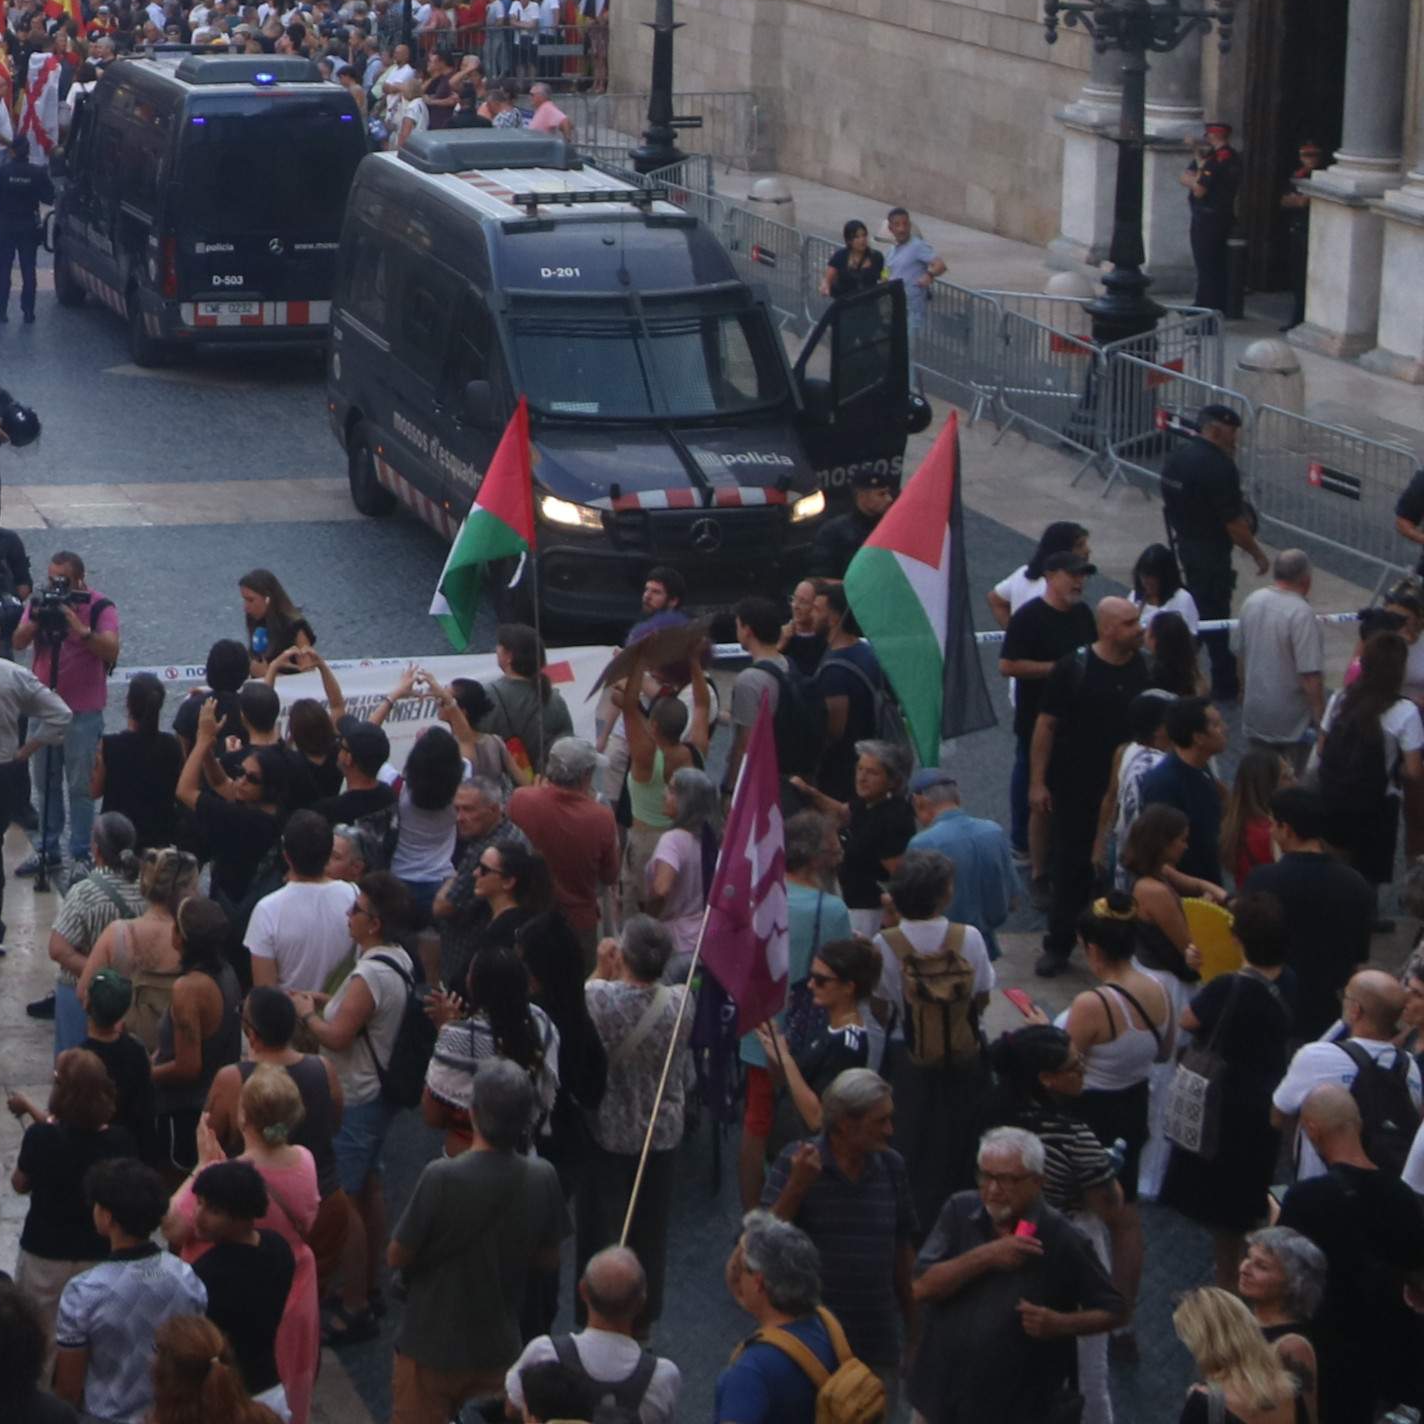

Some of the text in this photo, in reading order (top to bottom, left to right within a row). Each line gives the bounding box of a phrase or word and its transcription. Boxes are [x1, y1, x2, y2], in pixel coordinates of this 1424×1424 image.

[540, 267, 581, 278] D-201
[212, 275, 244, 285] D-503
[721, 451, 795, 466] policia
